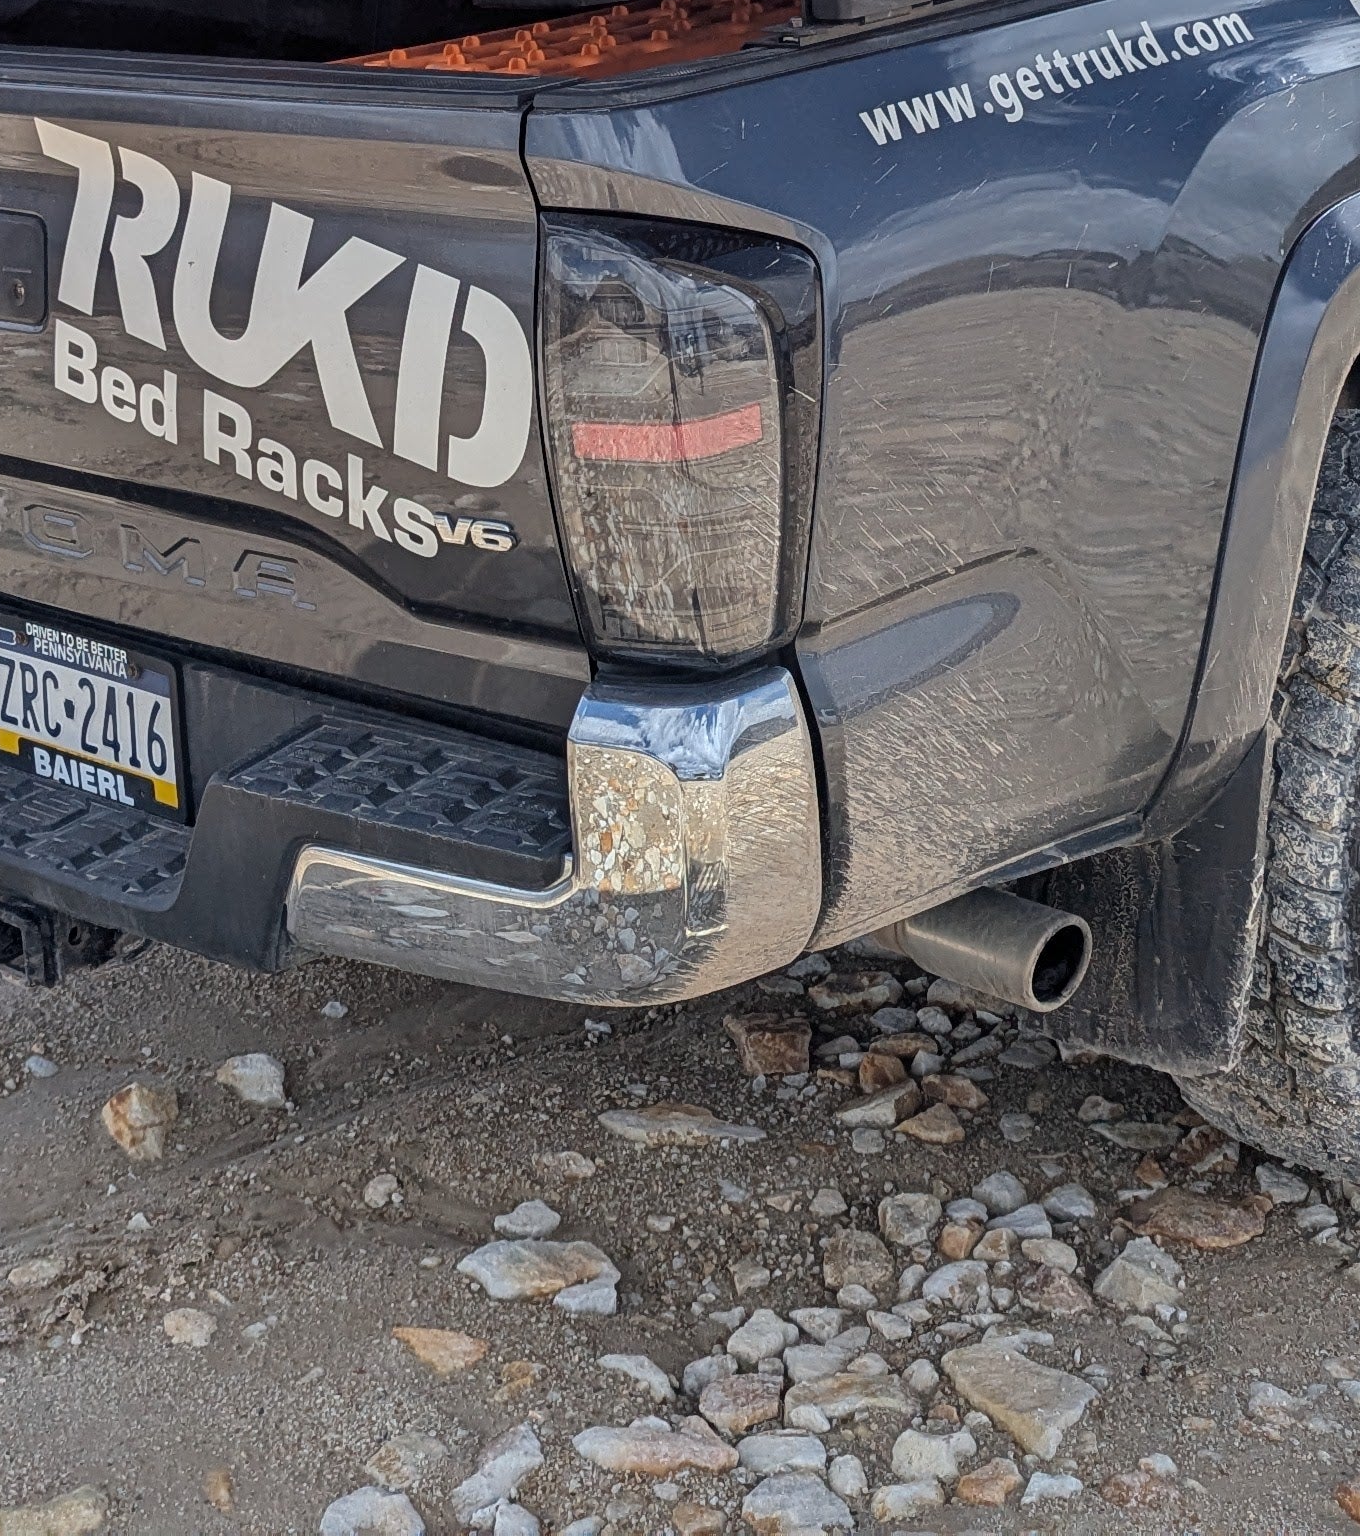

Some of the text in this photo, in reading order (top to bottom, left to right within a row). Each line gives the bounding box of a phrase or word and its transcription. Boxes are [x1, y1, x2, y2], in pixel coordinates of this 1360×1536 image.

[859, 8, 1254, 147] www.gettrukd.com
[54, 319, 439, 558] Bed Racks
[434, 512, 518, 552] V6
[25, 622, 128, 664] DRIVEN TO BE BETTER
[34, 637, 128, 679] PENNSYLVANIA
[33, 747, 135, 807] BAIERL
